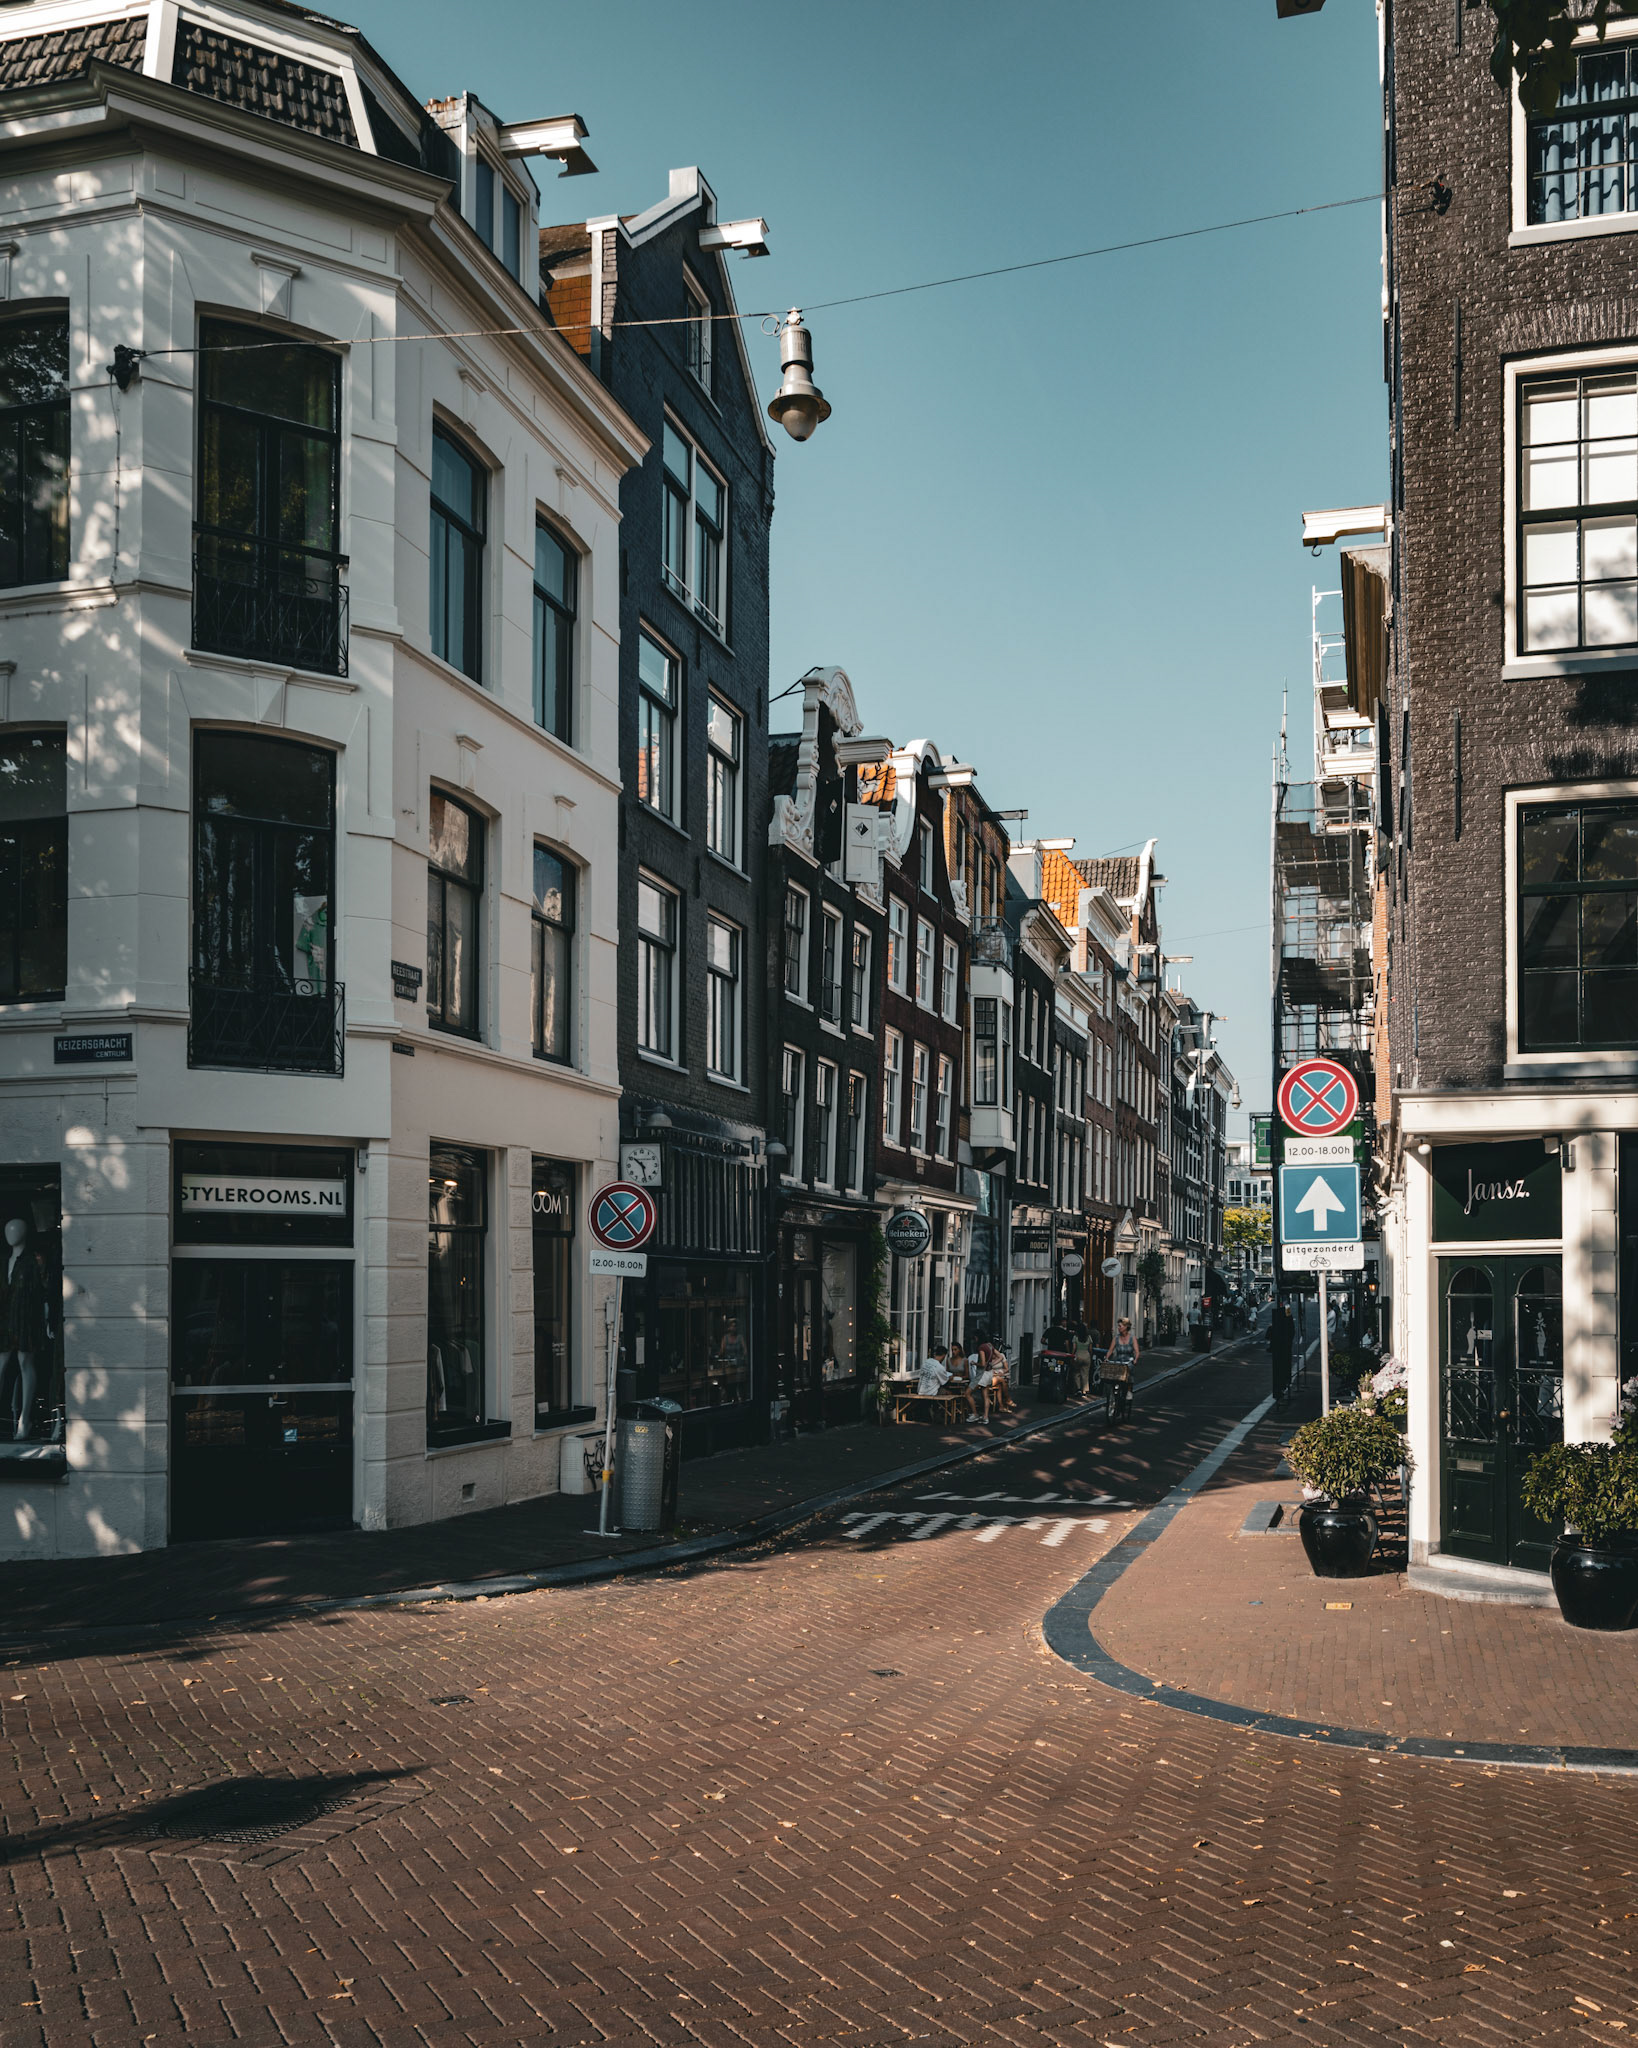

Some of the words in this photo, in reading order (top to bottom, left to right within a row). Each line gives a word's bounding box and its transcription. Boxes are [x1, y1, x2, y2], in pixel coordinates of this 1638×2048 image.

[57, 1038, 127, 1051] KEIZERSGRACHT
[1288, 1146, 1351, 1157] 12.00-18.00h
[181, 1186, 343, 1206] STYLEROOMS.NL
[889, 1229, 926, 1238] Heineken
[1286, 1244, 1355, 1255] uitgezonderd
[592, 1259, 643, 1270] 12.00-18.00h
